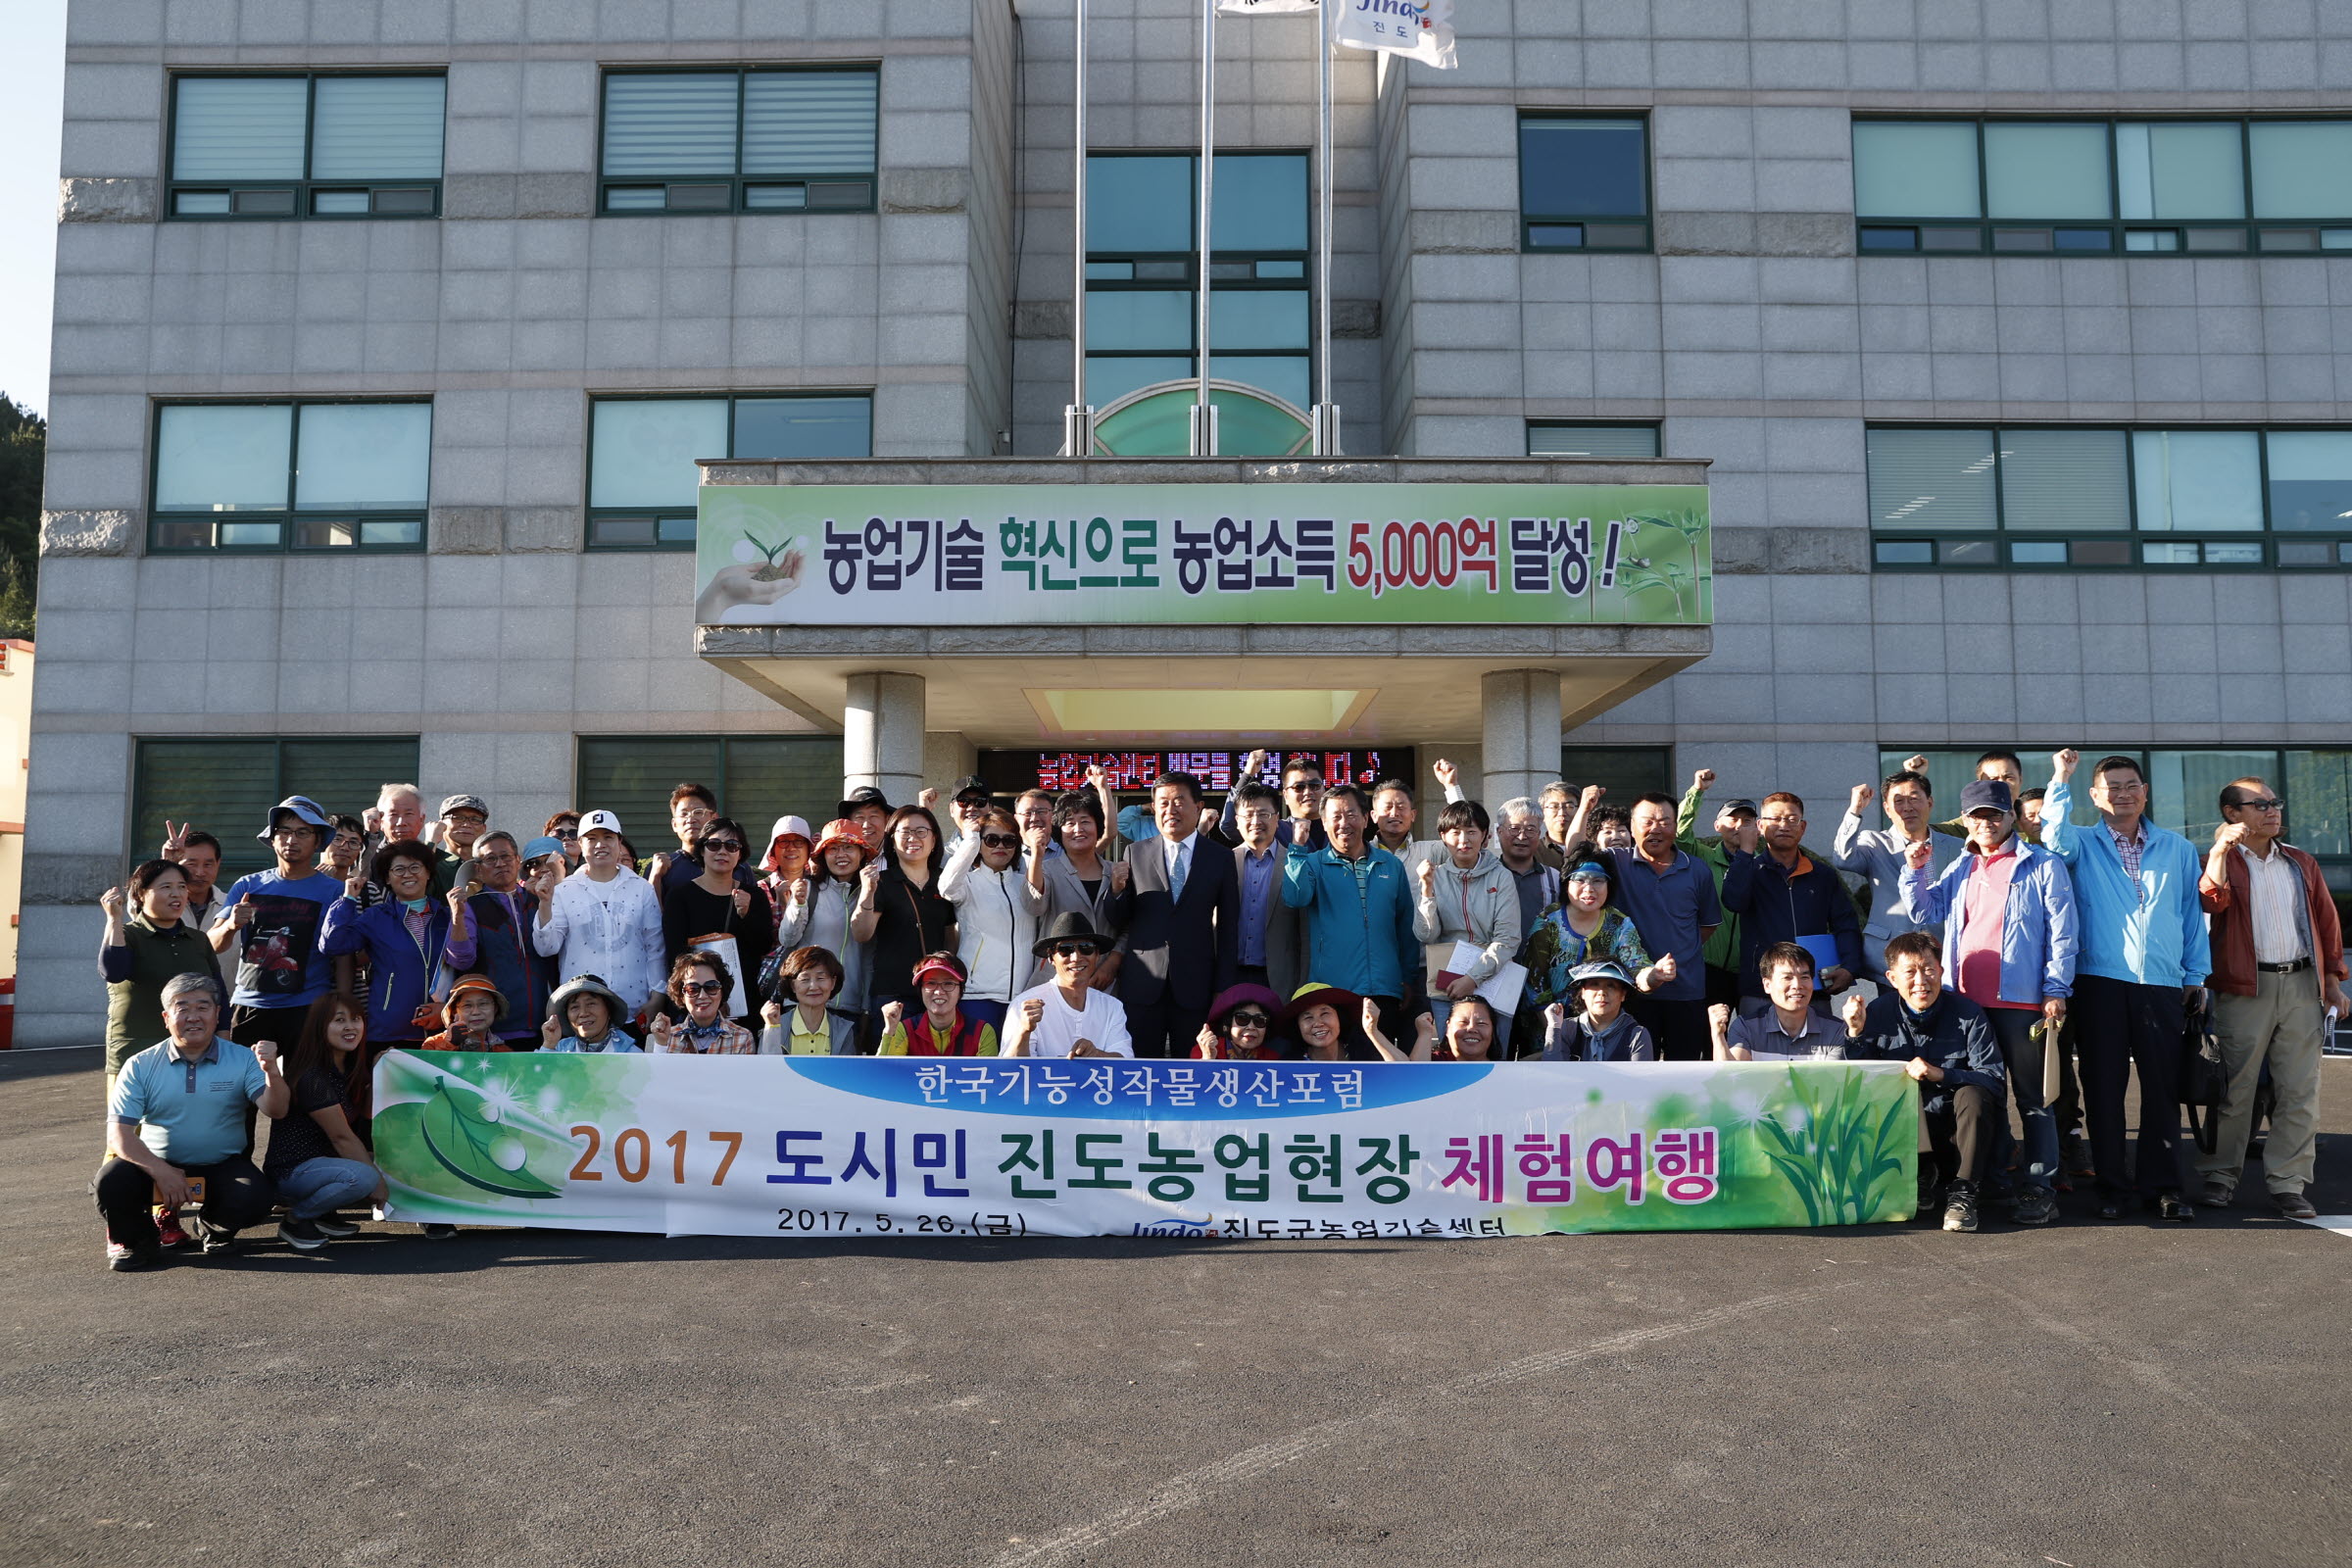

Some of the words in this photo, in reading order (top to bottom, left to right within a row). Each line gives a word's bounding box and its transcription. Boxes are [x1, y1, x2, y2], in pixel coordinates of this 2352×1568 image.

[823, 517, 984, 595] 농업기술
[1000, 516, 1159, 591] 혁신으로
[1174, 516, 1335, 594] 농업소득
[1348, 517, 1497, 595] 5,000억
[914, 1064, 1363, 1109] 한국기능성작물생산포럼
[569, 1125, 743, 1186] 2017
[766, 1128, 970, 1198] 도시민
[998, 1129, 1420, 1204] 진도농업현장
[1441, 1131, 1714, 1203] 체험여행
[778, 1208, 861, 1233] 2017.
